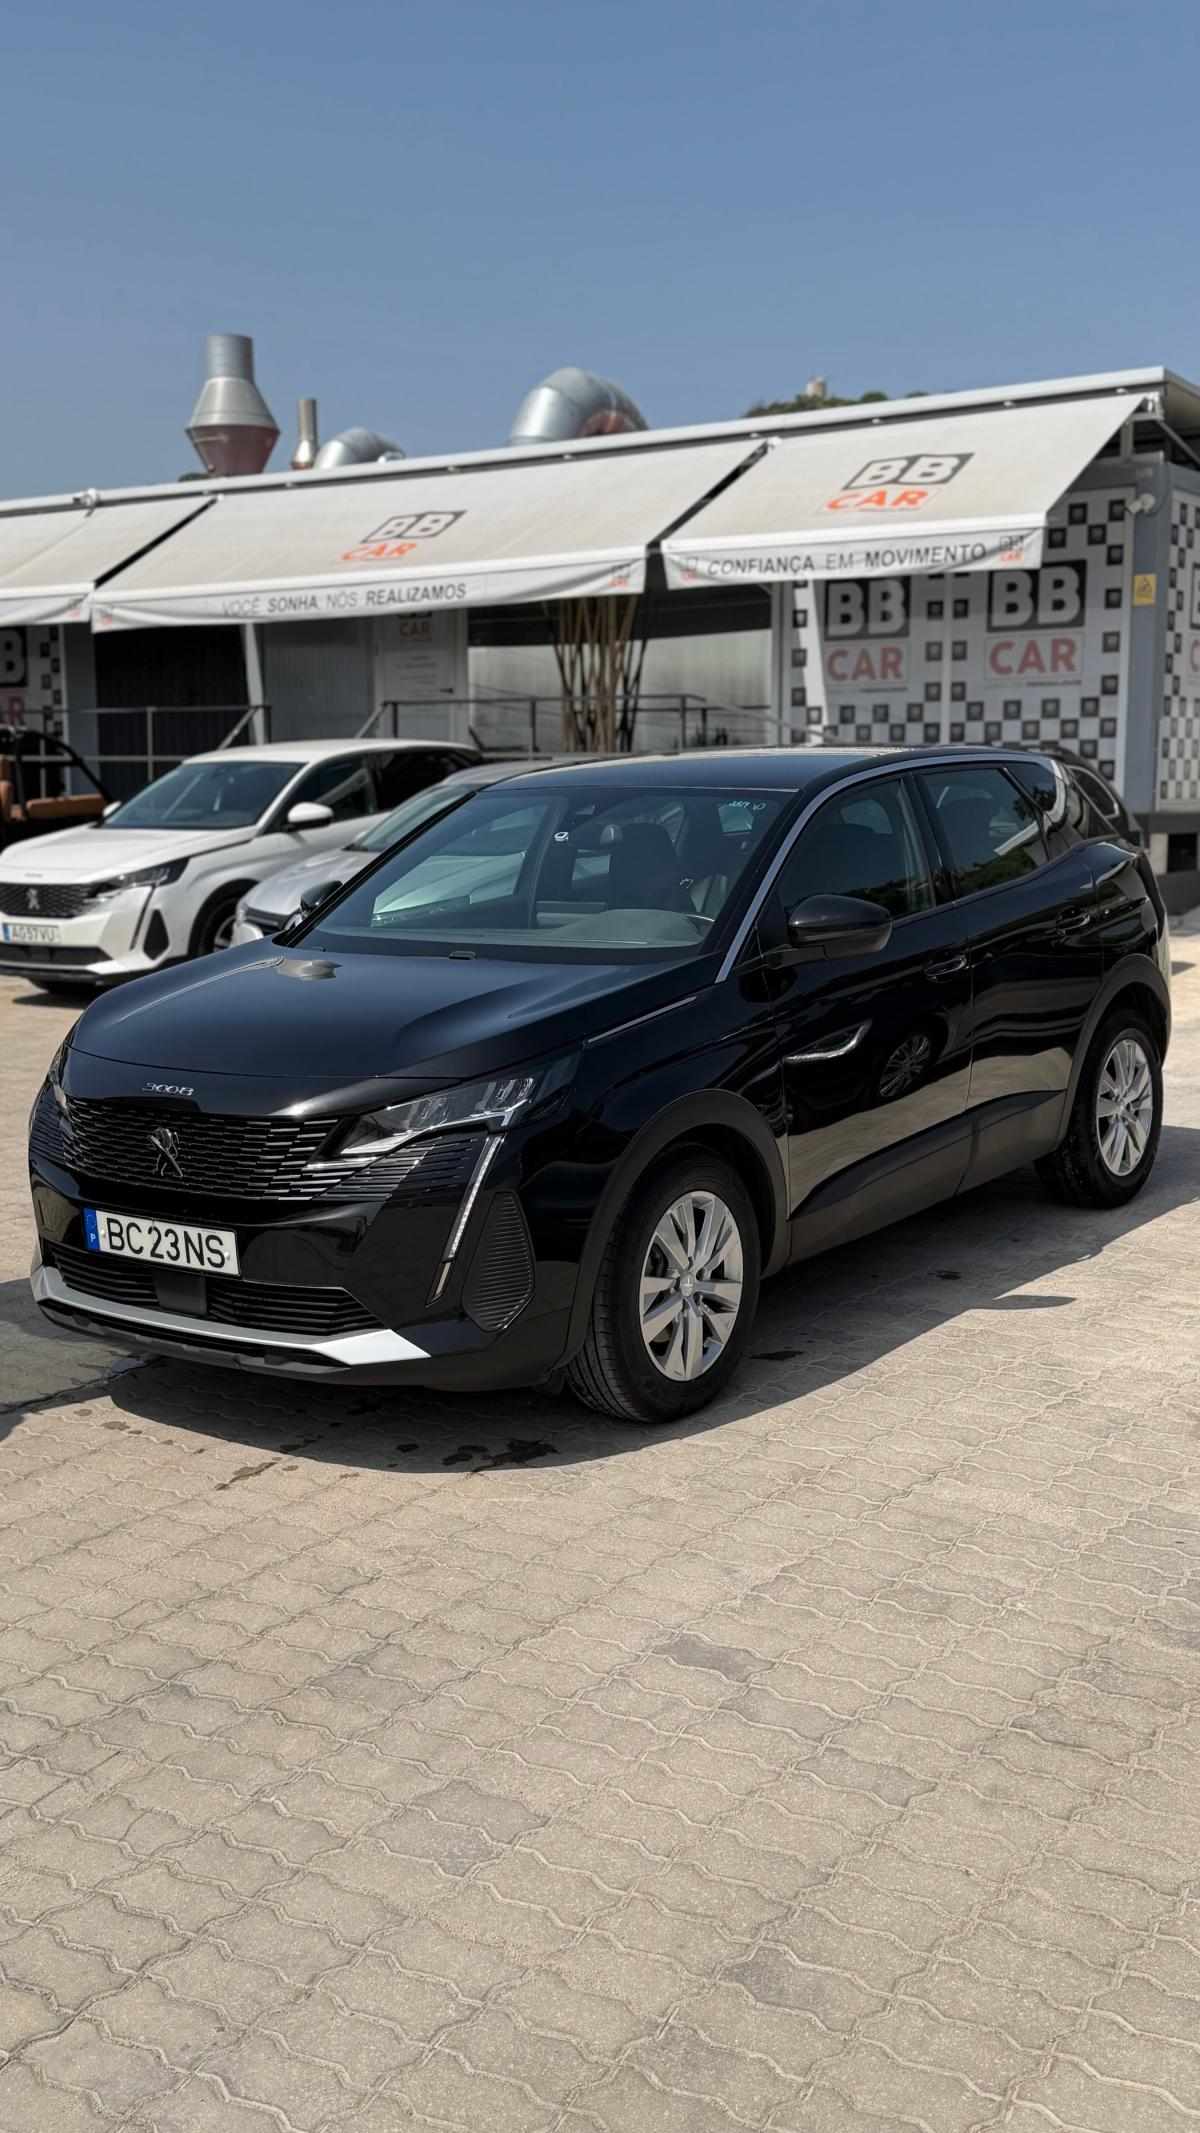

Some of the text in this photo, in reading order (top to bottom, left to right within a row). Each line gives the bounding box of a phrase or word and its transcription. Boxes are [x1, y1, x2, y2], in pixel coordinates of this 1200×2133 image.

[847, 453, 970, 489] BB
[826, 489, 928, 510] CAR
[365, 511, 460, 543] BB
[341, 542, 417, 561] CAR
[707, 555, 816, 575] CONFIANÇA
[825, 552, 855, 570] EM
[865, 542, 987, 567] MOVIMENTO
[267, 594, 319, 613] SONHA
[365, 583, 467, 606] REALIZAMOS
[828, 579, 905, 636] BB
[992, 566, 1081, 628] BB
[827, 647, 904, 681] CAR
[989, 637, 1077, 675] CAR
